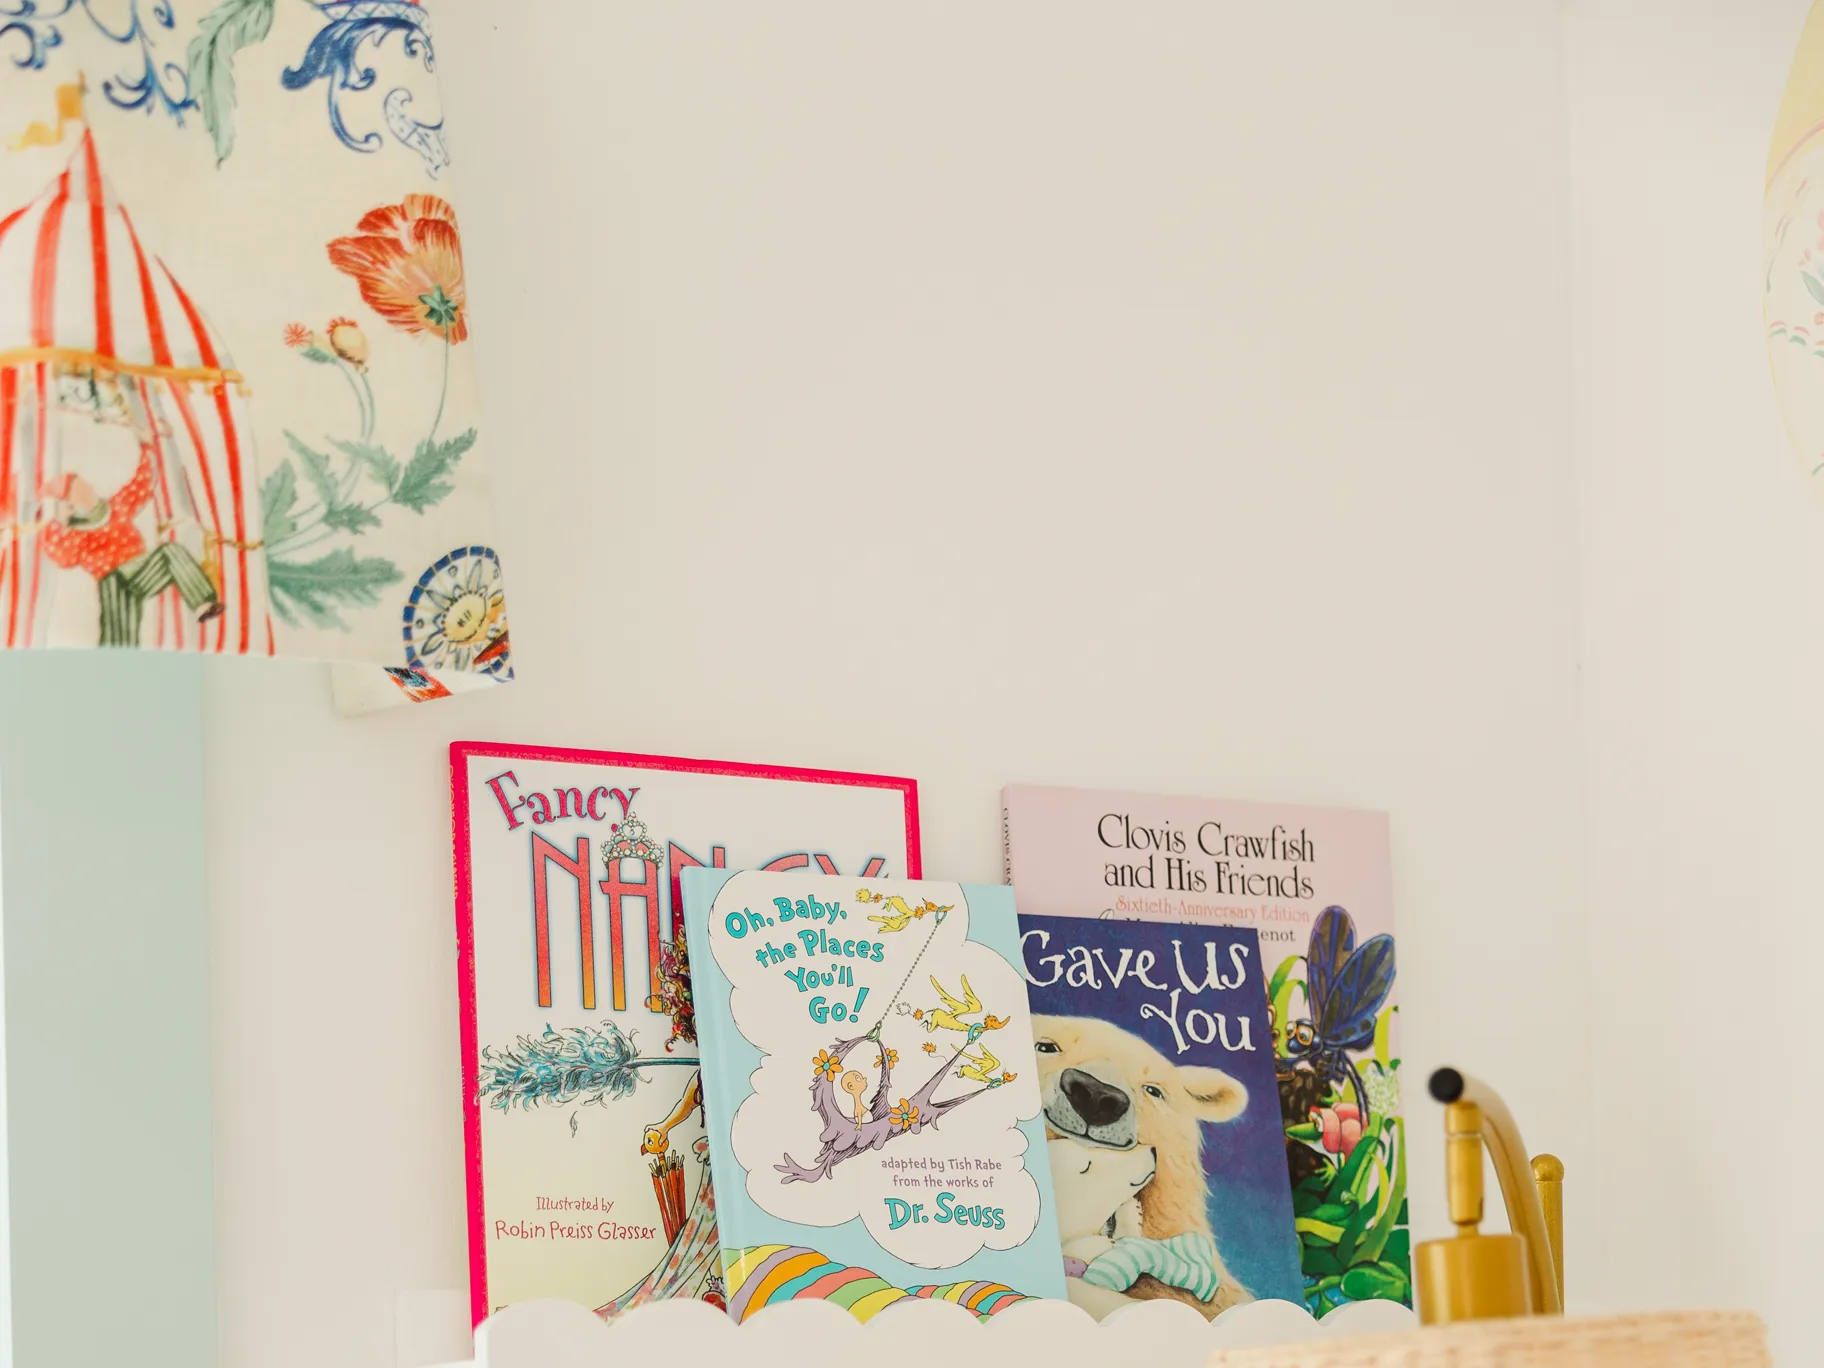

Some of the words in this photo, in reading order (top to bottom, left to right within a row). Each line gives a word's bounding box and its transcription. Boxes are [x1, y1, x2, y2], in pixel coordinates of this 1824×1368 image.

[485, 771, 641, 831] Fancy
[1097, 813, 1187, 854] Clovis
[1197, 821, 1316, 863] Crawfish
[1103, 854, 1156, 889] and
[1164, 857, 1208, 893] His
[1214, 860, 1315, 900] Friends
[725, 906, 775, 939] Oh,
[772, 894, 848, 925] Baby,
[1115, 895, 1257, 922] Sixtieth-Anniversary
[1260, 905, 1311, 923] Edition
[755, 941, 798, 969] the
[796, 928, 885, 963] Places
[1260, 929, 1297, 942] enot
[783, 963, 854, 993] You'll
[1020, 929, 1169, 988] Gave
[808, 986, 870, 1025] Go!
[1139, 988, 1257, 1056] You
[881, 1156, 928, 1173] adapted
[929, 1157, 946, 1173] by
[947, 1157, 972, 1171] Tish
[974, 1158, 1002, 1171] Rabe
[892, 1174, 921, 1187] from
[923, 1173, 943, 1187] the
[945, 1175, 980, 1188] works
[982, 1176, 995, 1188] of
[535, 1196, 599, 1211] Illustrated
[601, 1197, 615, 1214] by
[883, 1197, 930, 1231] Dr.
[933, 1191, 1006, 1231] Seuss
[495, 1219, 546, 1240] Robin
[549, 1220, 594, 1240] Preiss
[597, 1221, 657, 1240] Glasser
